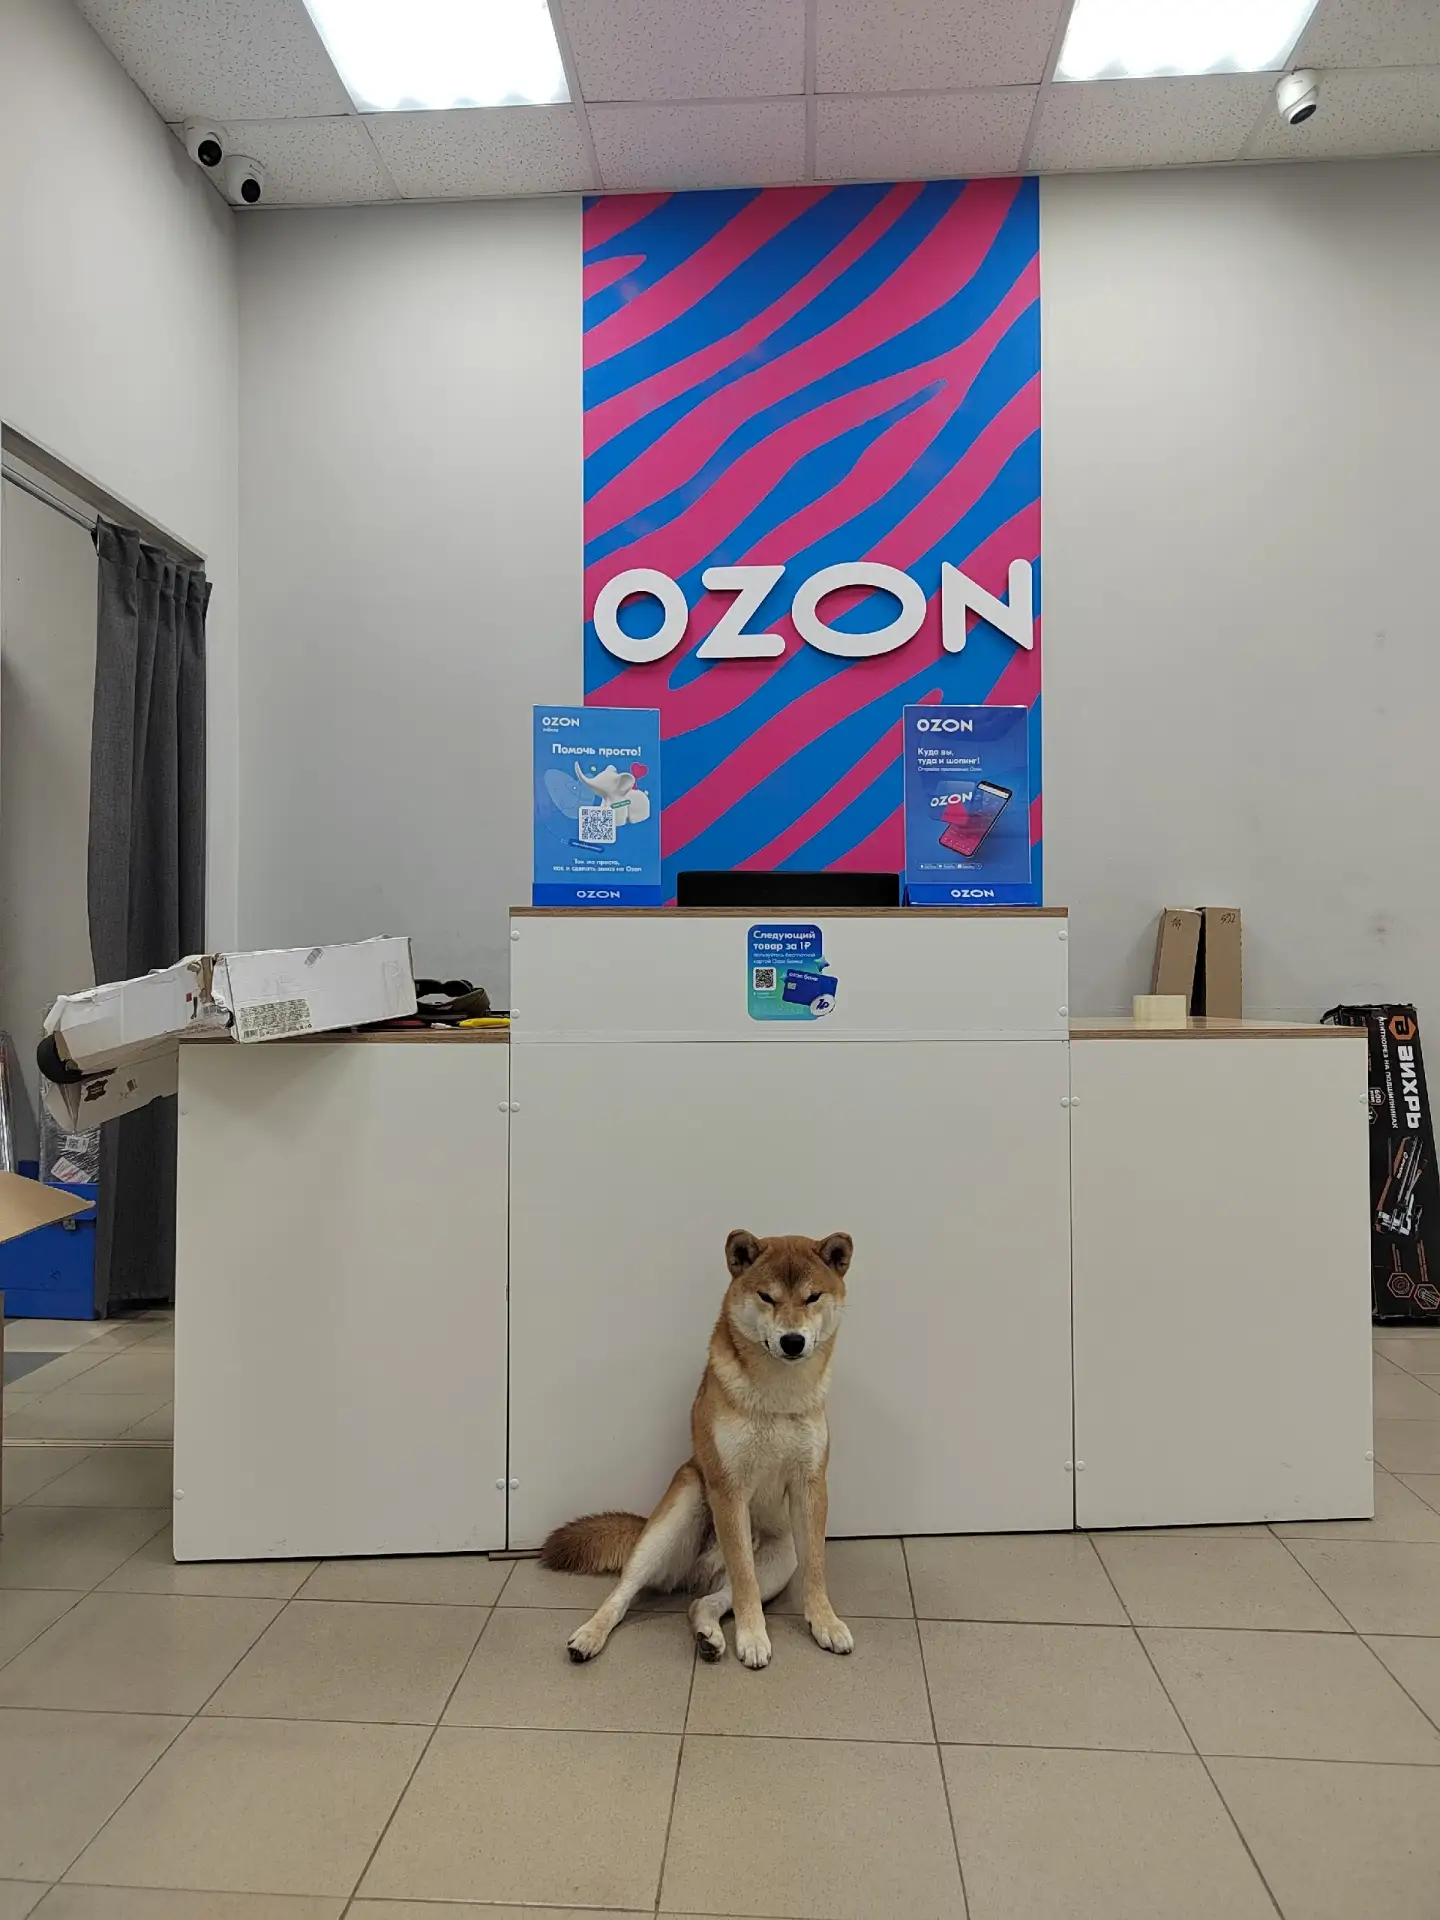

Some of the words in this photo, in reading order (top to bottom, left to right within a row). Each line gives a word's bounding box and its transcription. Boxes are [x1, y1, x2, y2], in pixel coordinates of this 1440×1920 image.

[593, 558, 1034, 663] OZON
[542, 717, 580, 727] OZON
[917, 719, 973, 732] OZON
[552, 743, 595, 755] Помочь
[598, 746, 641, 757] просто!
[917, 748, 939, 757] Куда
[940, 749, 954, 757] вы,
[930, 791, 973, 807] OZON
[576, 890, 620, 899] OZON
[950, 889, 994, 898] OZON
[753, 930, 816, 939] Следующий
[753, 943, 783, 951] товар
[800, 942, 811, 950] 1₽
[1383, 1059, 1391, 1070] НА
[1397, 1045, 1422, 1129] ВИХРЬ
[1374, 1089, 1382, 1103] 600
[1385, 1072, 1399, 1129] ПОДШИПНИКАХ
